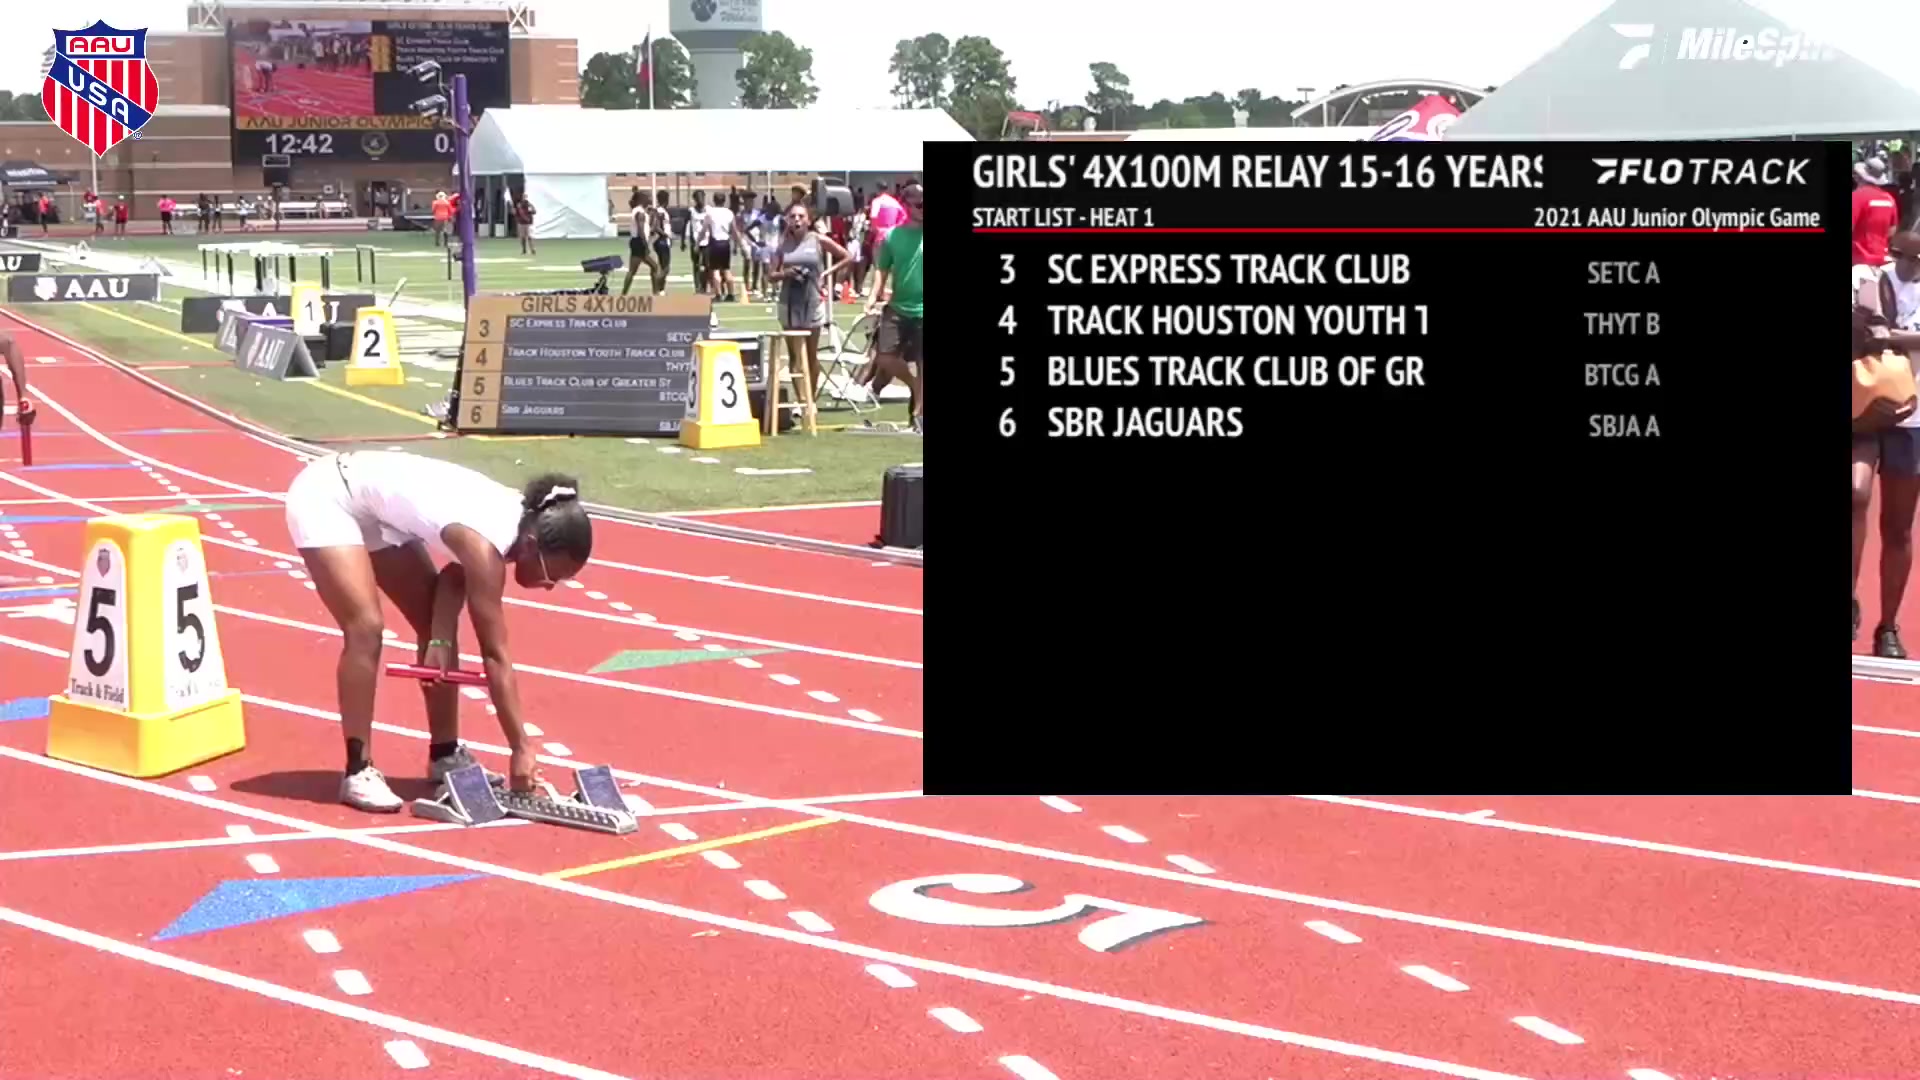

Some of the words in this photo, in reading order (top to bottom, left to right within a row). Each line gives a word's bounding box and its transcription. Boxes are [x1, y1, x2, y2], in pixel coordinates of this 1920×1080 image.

[288, 115, 350, 129] JUNIOR
[265, 133, 334, 154] 12:42
[64, 278, 130, 298] AAU
[305, 301, 313, 321] 1
[521, 296, 577, 313] GIRLS
[583, 296, 652, 313] 4X100M
[479, 320, 489, 337] 3
[509, 319, 525, 329] SC
[526, 319, 566, 329] EXPRESS
[568, 318, 599, 328] TRACK
[601, 318, 628, 328] CLUB
[363, 330, 380, 357] 2
[666, 332, 692, 343] SETC
[476, 349, 487, 366] 4
[507, 348, 538, 358] TRACK
[540, 348, 586, 358] HOUSTON
[588, 348, 622, 358] YOUTH
[625, 348, 656, 358] TRACK
[658, 348, 685, 358] CLUB
[474, 377, 485, 395] 5
[504, 377, 534, 387] BLUES
[536, 377, 566, 387] TRACK
[568, 377, 595, 387] CLUB
[611, 378, 657, 388] GREATER
[720, 371, 737, 408] 3
[471, 406, 481, 424] 6
[522, 405, 564, 415] JAGUARS
[84, 586, 117, 677] 5
[176, 582, 205, 673] 5
[71, 678, 94, 698] Track
[95, 682, 103, 699] &
[104, 684, 125, 703] Field
[868, 873, 1212, 952] 5
